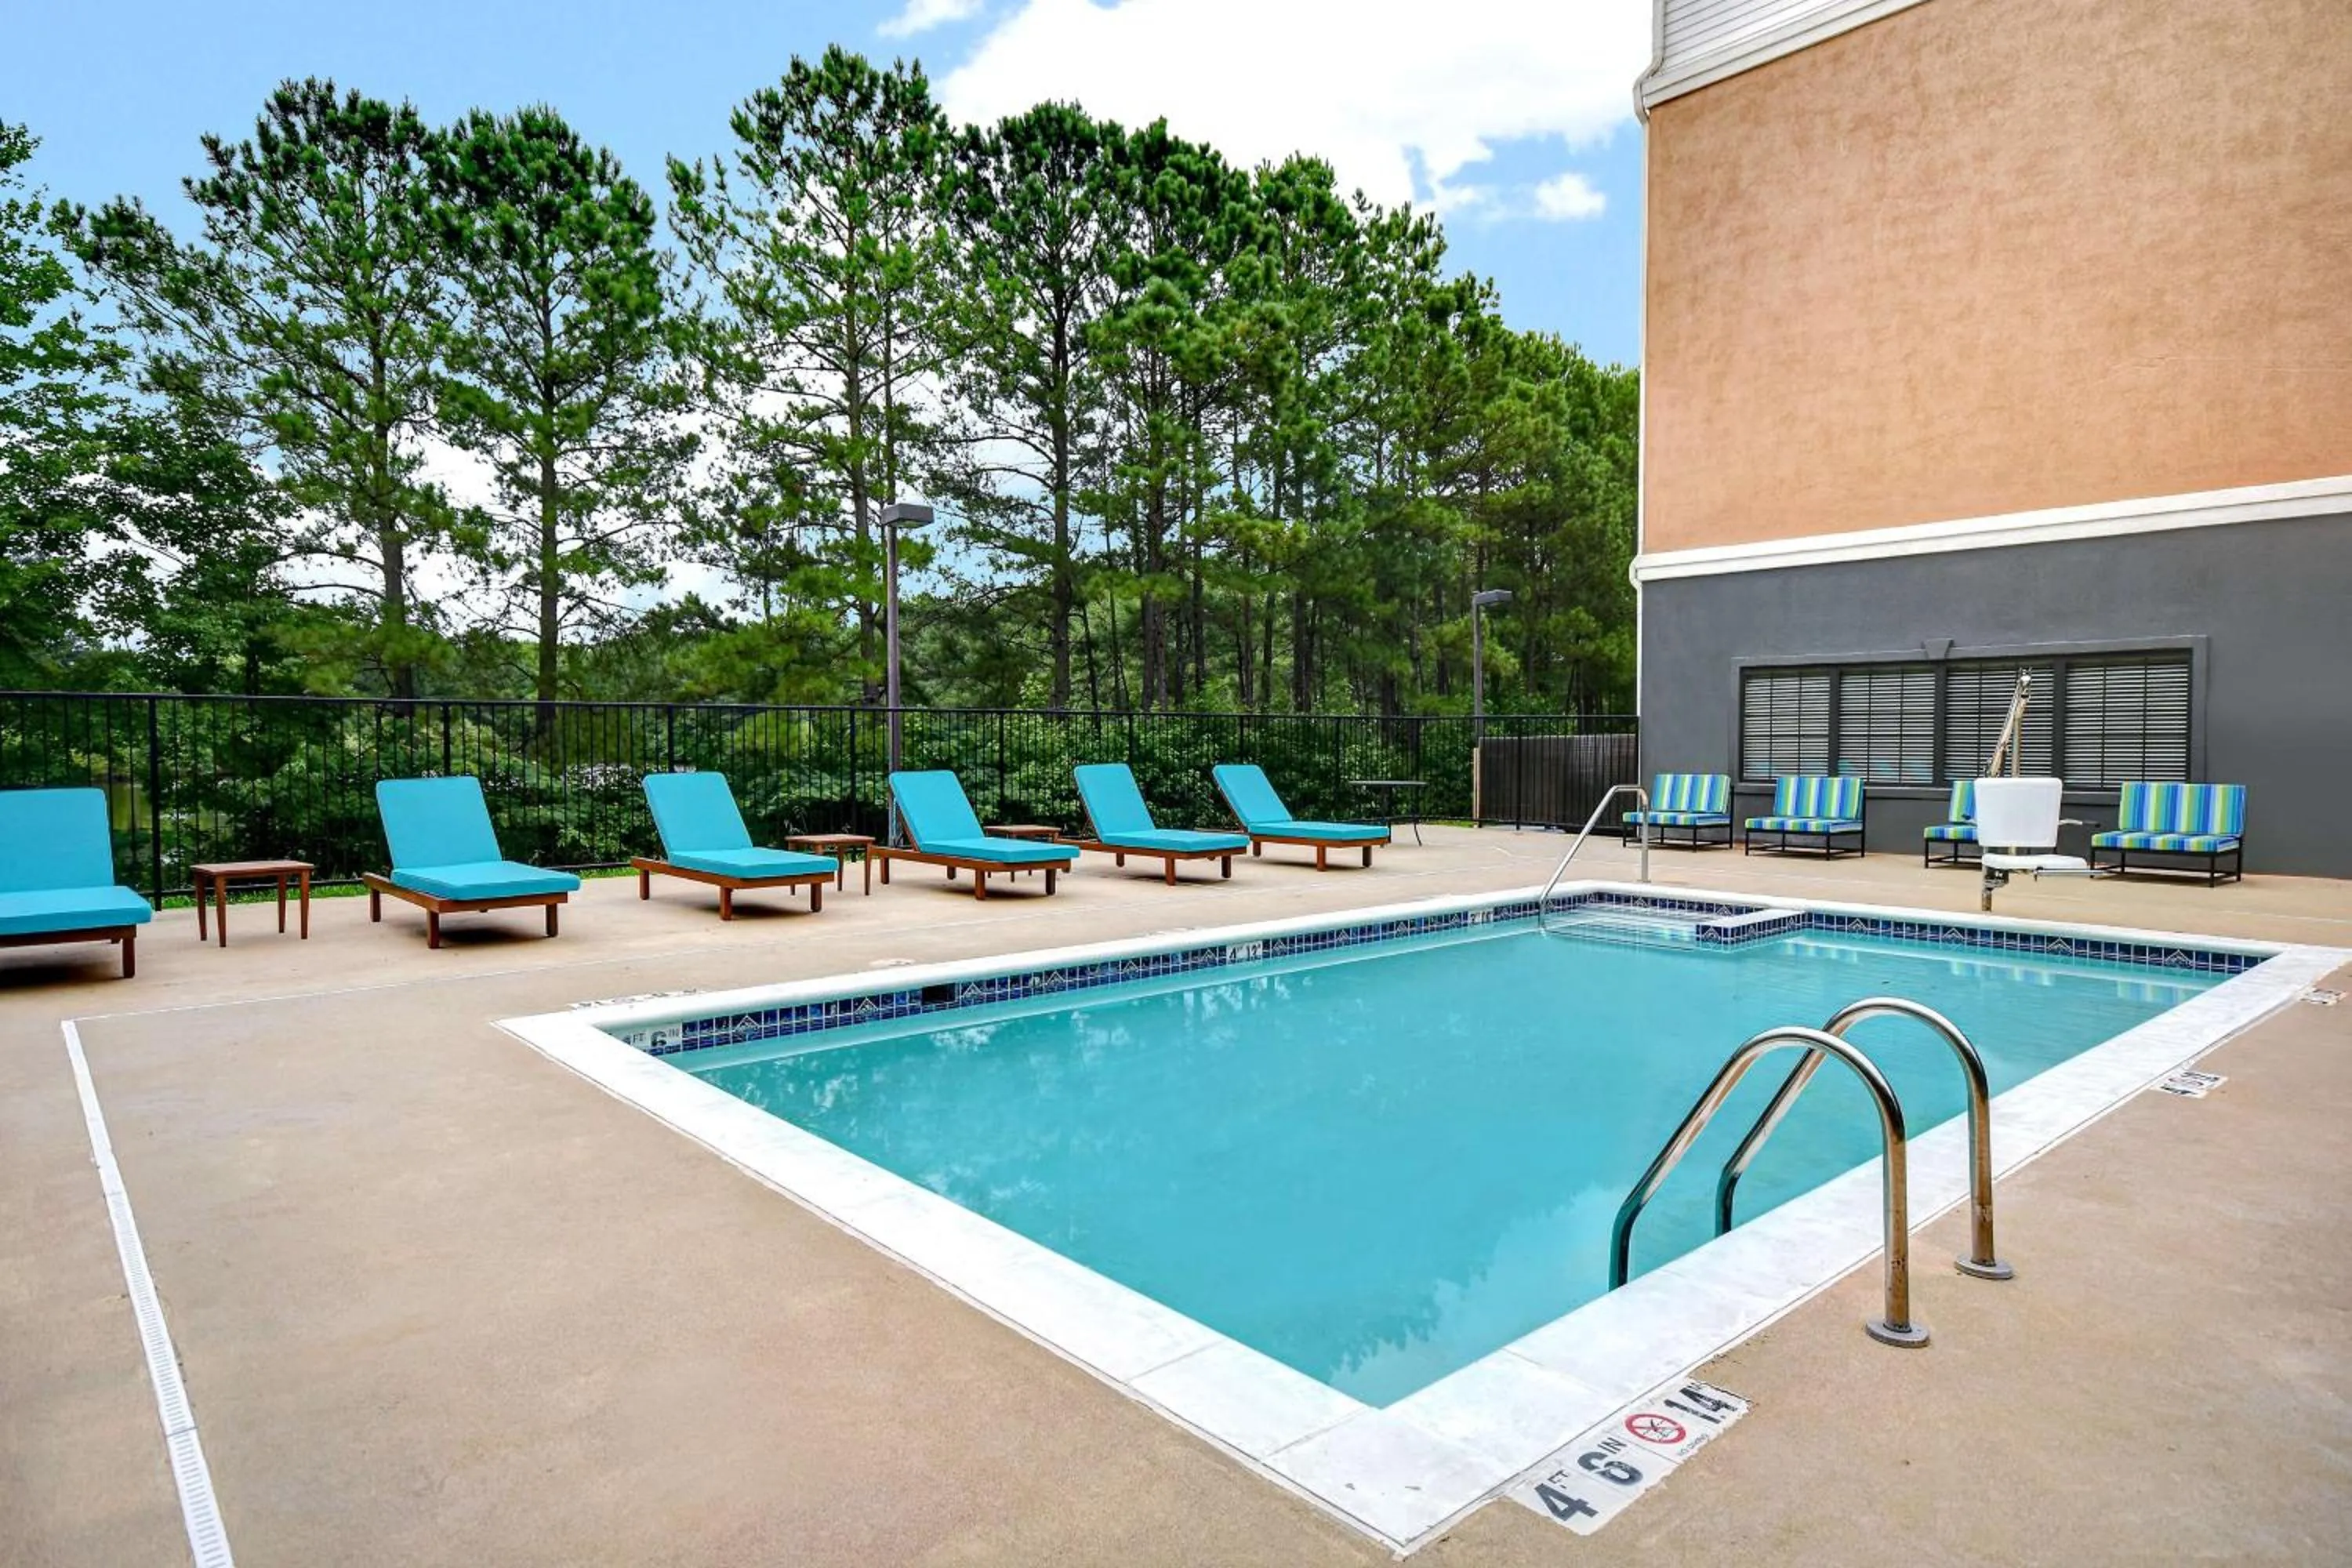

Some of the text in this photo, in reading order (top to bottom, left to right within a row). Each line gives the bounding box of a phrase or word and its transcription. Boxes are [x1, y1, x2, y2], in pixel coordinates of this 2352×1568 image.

[651, 1030, 667, 1047] 6
[1597, 1437, 1628, 1454] IN
[1577, 1451, 1643, 1486] 6
[1534, 1483, 1599, 1521] 4
